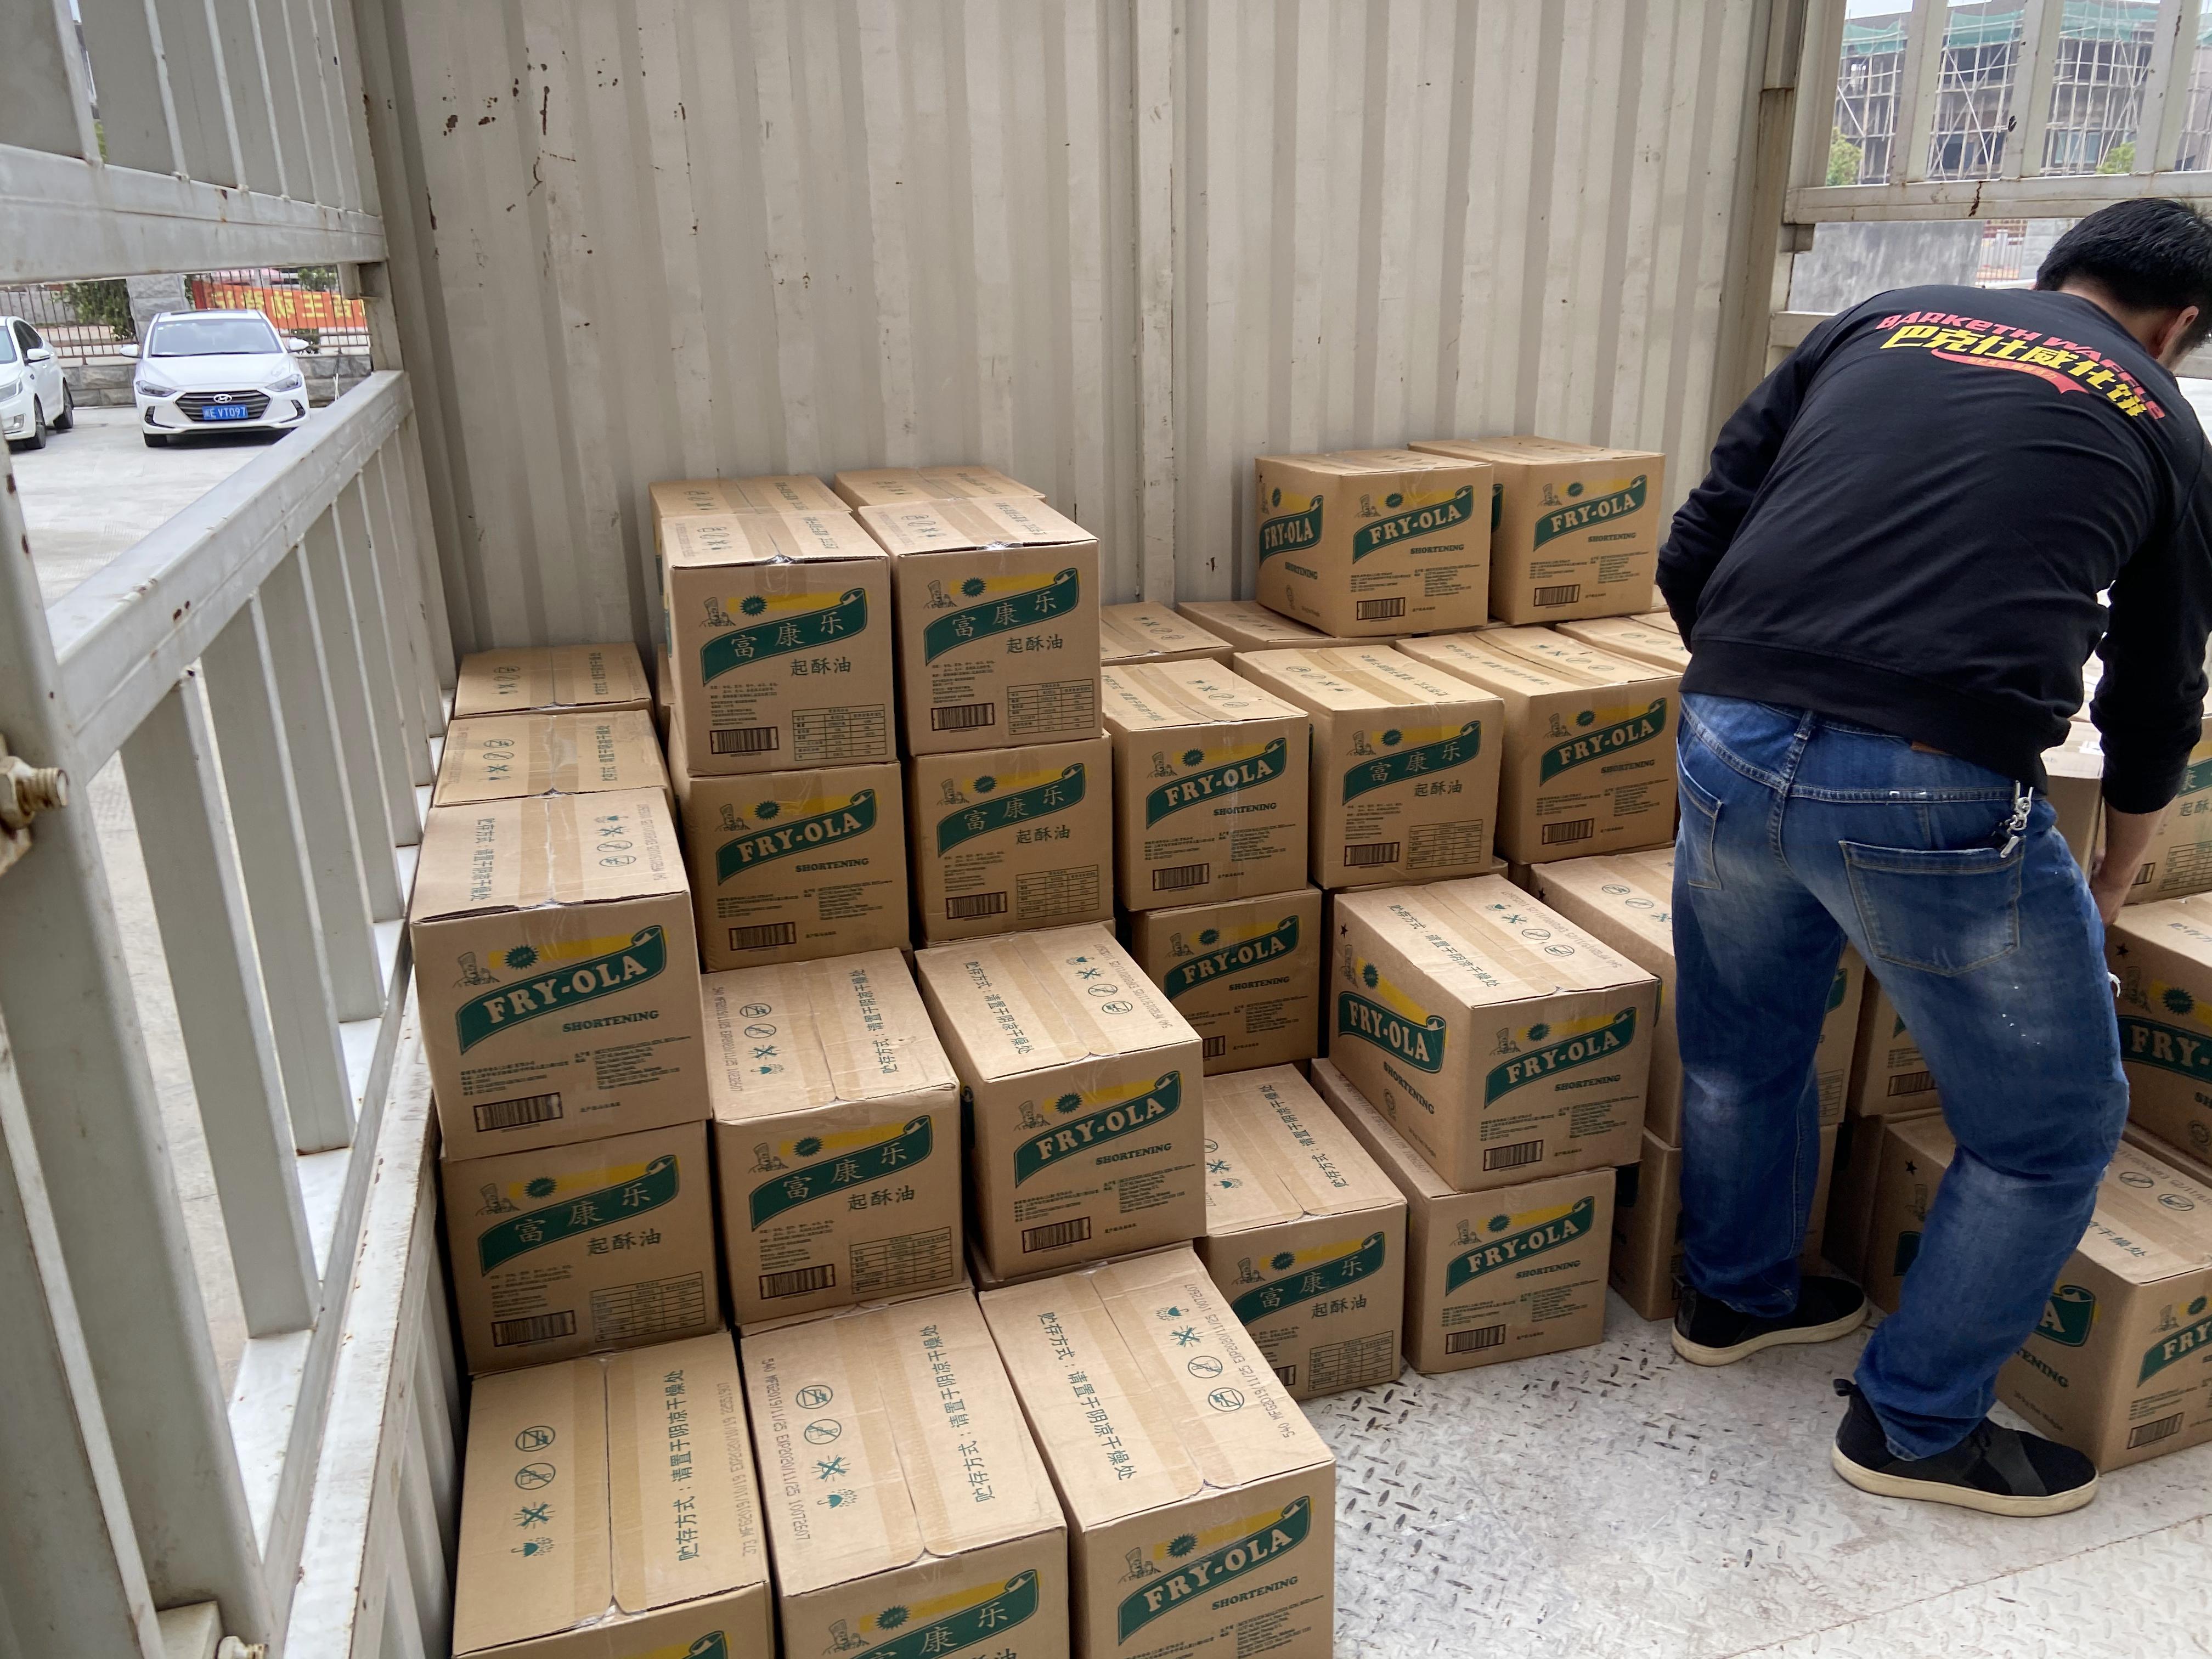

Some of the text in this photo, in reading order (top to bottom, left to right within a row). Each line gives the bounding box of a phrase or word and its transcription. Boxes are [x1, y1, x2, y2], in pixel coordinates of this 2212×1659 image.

[1880, 325, 2147, 416] 巴克仕威化饼
[1370, 503, 1462, 545] FRY-OLA
[1550, 494, 1636, 533] FRY-OLA
[1264, 518, 1314, 550] FRY-OLA
[1410, 544, 1464, 554] SHORTENING
[1588, 533, 1637, 543] SHORTENING
[1285, 561, 1318, 579] SHORTENING
[952, 590, 1058, 638] 富康乐
[730, 608, 844, 658] 富康乐
[1006, 635, 1063, 654] 起酥油
[790, 657, 852, 676] 起酥油
[1559, 719, 1655, 765] FRY-OLA
[1370, 741, 1461, 782] 富康乐
[1601, 759, 1655, 774] SHORTENING
[1164, 759, 1274, 808] FRY-OLA
[1414, 780, 1462, 797] 起酥油
[964, 785, 1064, 831] 富康乐
[1213, 803, 1277, 816] SHORTENING
[2177, 798, 2212, 817] 起酥
[736, 812, 862, 863] FRY-OLA
[1016, 825, 1070, 845] 起酥油
[795, 858, 870, 872] SHORTENING
[1182, 936, 1286, 984] FRY-OLA
[482, 955, 648, 1024] FRY-OLA
[1228, 977, 1289, 991] SHORTENING
[562, 1010, 659, 1032] SHORTENING
[1348, 1001, 1431, 1062] FRY-OLA
[1506, 1029, 1621, 1085] FRY-OLA
[1384, 1062, 1434, 1115] SHORTENING
[1554, 1074, 1621, 1092] SHORTENING
[1036, 1098, 1166, 1160] FRY-OLA
[783, 1142, 907, 1198] 富康乐
[1096, 1143, 1172, 1165] SHORTENING
[514, 1183, 651, 1243] 富康乐
[847, 1184, 915, 1211] 起酥油
[586, 1228, 661, 1256] 起酥油
[1467, 1218, 1579, 1273] FRY-OLA
[1260, 1256, 1363, 1308] 富康乐
[1515, 1260, 1581, 1279] SHORTENING
[1311, 1294, 1367, 1318] 起酥油
[1238, 1364, 1286, 1419] MFG2019/11/25
[1278, 1423, 1295, 1438] 540
[1143, 1529, 1293, 1612] FRY-OLA
[1212, 1576, 1298, 1610] SHORTENING
